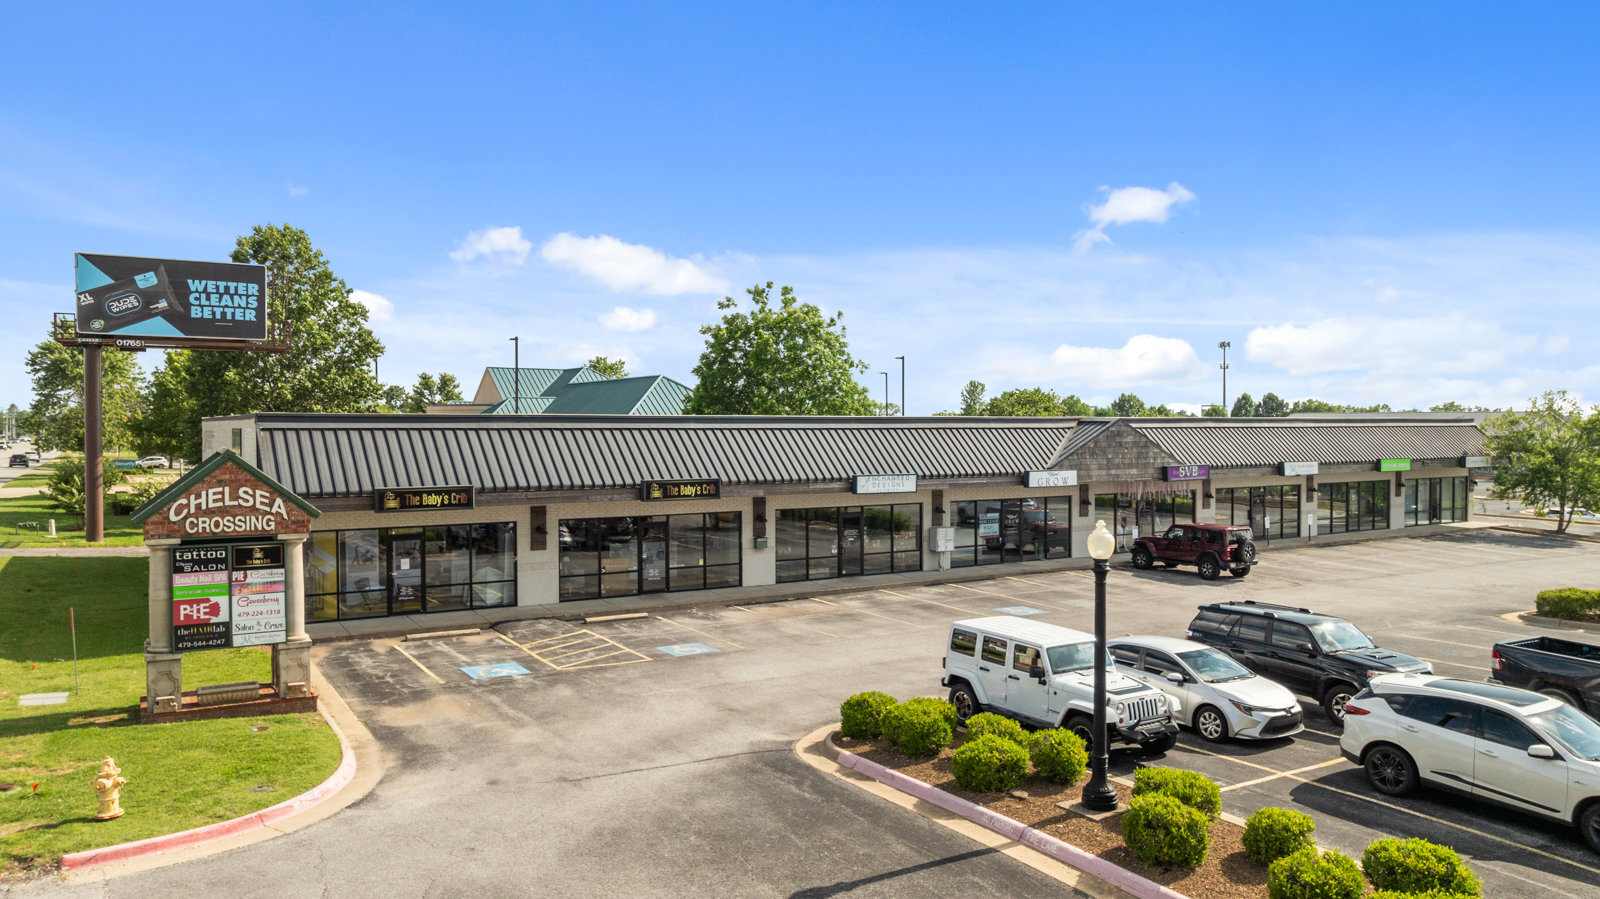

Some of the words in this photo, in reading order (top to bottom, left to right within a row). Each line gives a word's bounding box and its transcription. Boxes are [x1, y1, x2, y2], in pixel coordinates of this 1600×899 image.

[186, 279, 259, 295] WETTER
[78, 293, 93, 302] XL
[189, 293, 259, 308] CLEANS
[111, 301, 139, 313] WIPES
[190, 305, 257, 321] BETTER
[116, 339, 145, 347] 017651
[1179, 466, 1198, 477] SVB
[1037, 477, 1069, 487] GROW
[666, 485, 679, 496] The
[680, 484, 701, 497] Baby's
[702, 483, 716, 495] Crib
[169, 486, 288, 522] CHELSEA
[405, 493, 420, 506] The
[422, 492, 449, 507] Baby's
[451, 492, 468, 504] Crib
[185, 515, 276, 534] CROSSING
[175, 550, 226, 560] tattoo
[183, 563, 226, 572] SALON
[175, 575, 198, 585] Beauty
[199, 574, 212, 583] Nail
[213, 573, 226, 582] SPA
[237, 595, 279, 607] Gooseberry
[180, 602, 210, 620] PIE
[234, 623, 254, 632] Salon
[178, 638, 225, 648] 479-544-4247
[1026, 831, 1040, 846] FIRE
[1041, 839, 1060, 854] LANE
